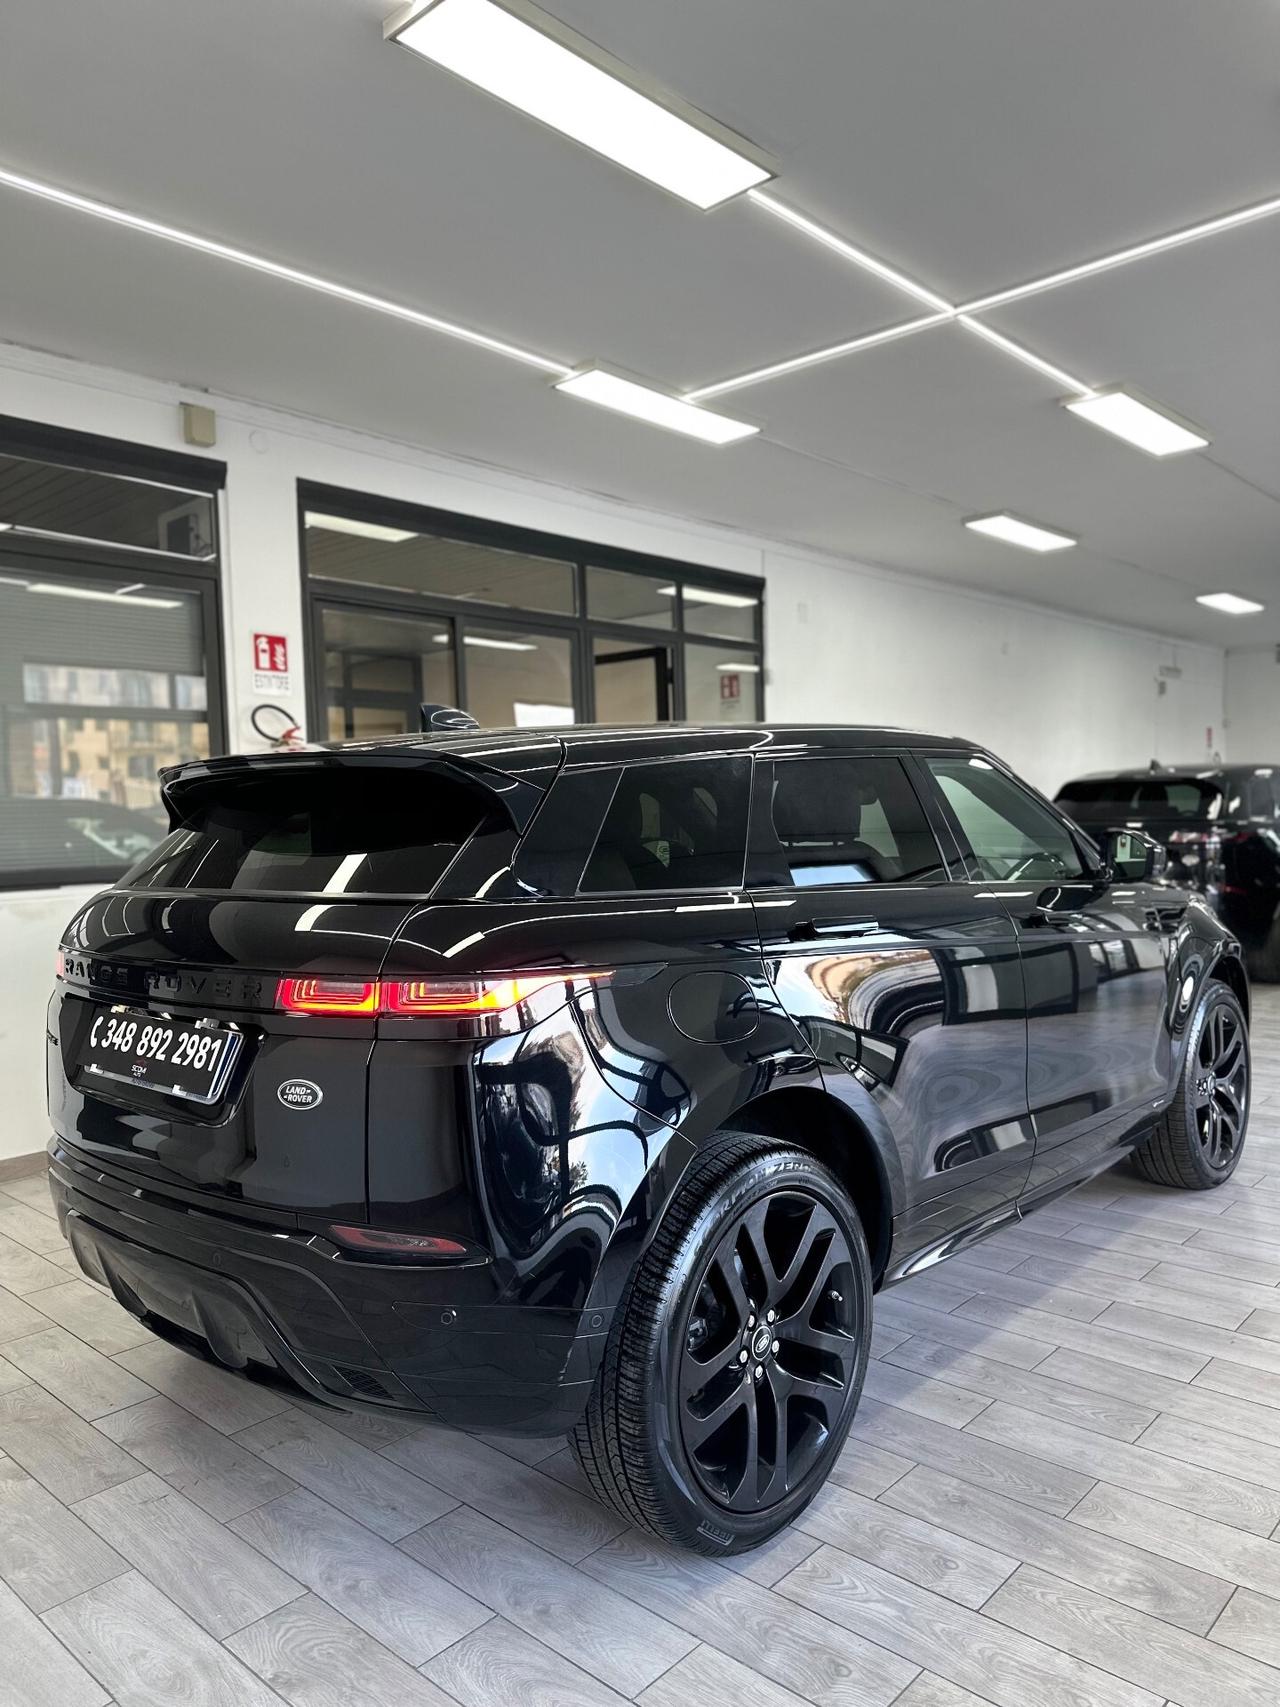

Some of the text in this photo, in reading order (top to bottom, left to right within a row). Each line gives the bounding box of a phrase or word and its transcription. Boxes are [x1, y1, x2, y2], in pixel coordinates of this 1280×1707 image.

[65, 957, 262, 1000] RANGE ROVER
[101, 1018, 138, 1053] 348
[136, 1025, 173, 1061] 892
[171, 1032, 222, 1072] 2981
[285, 1085, 306, 1095] LAND
[287, 1093, 312, 1103] ROVER
